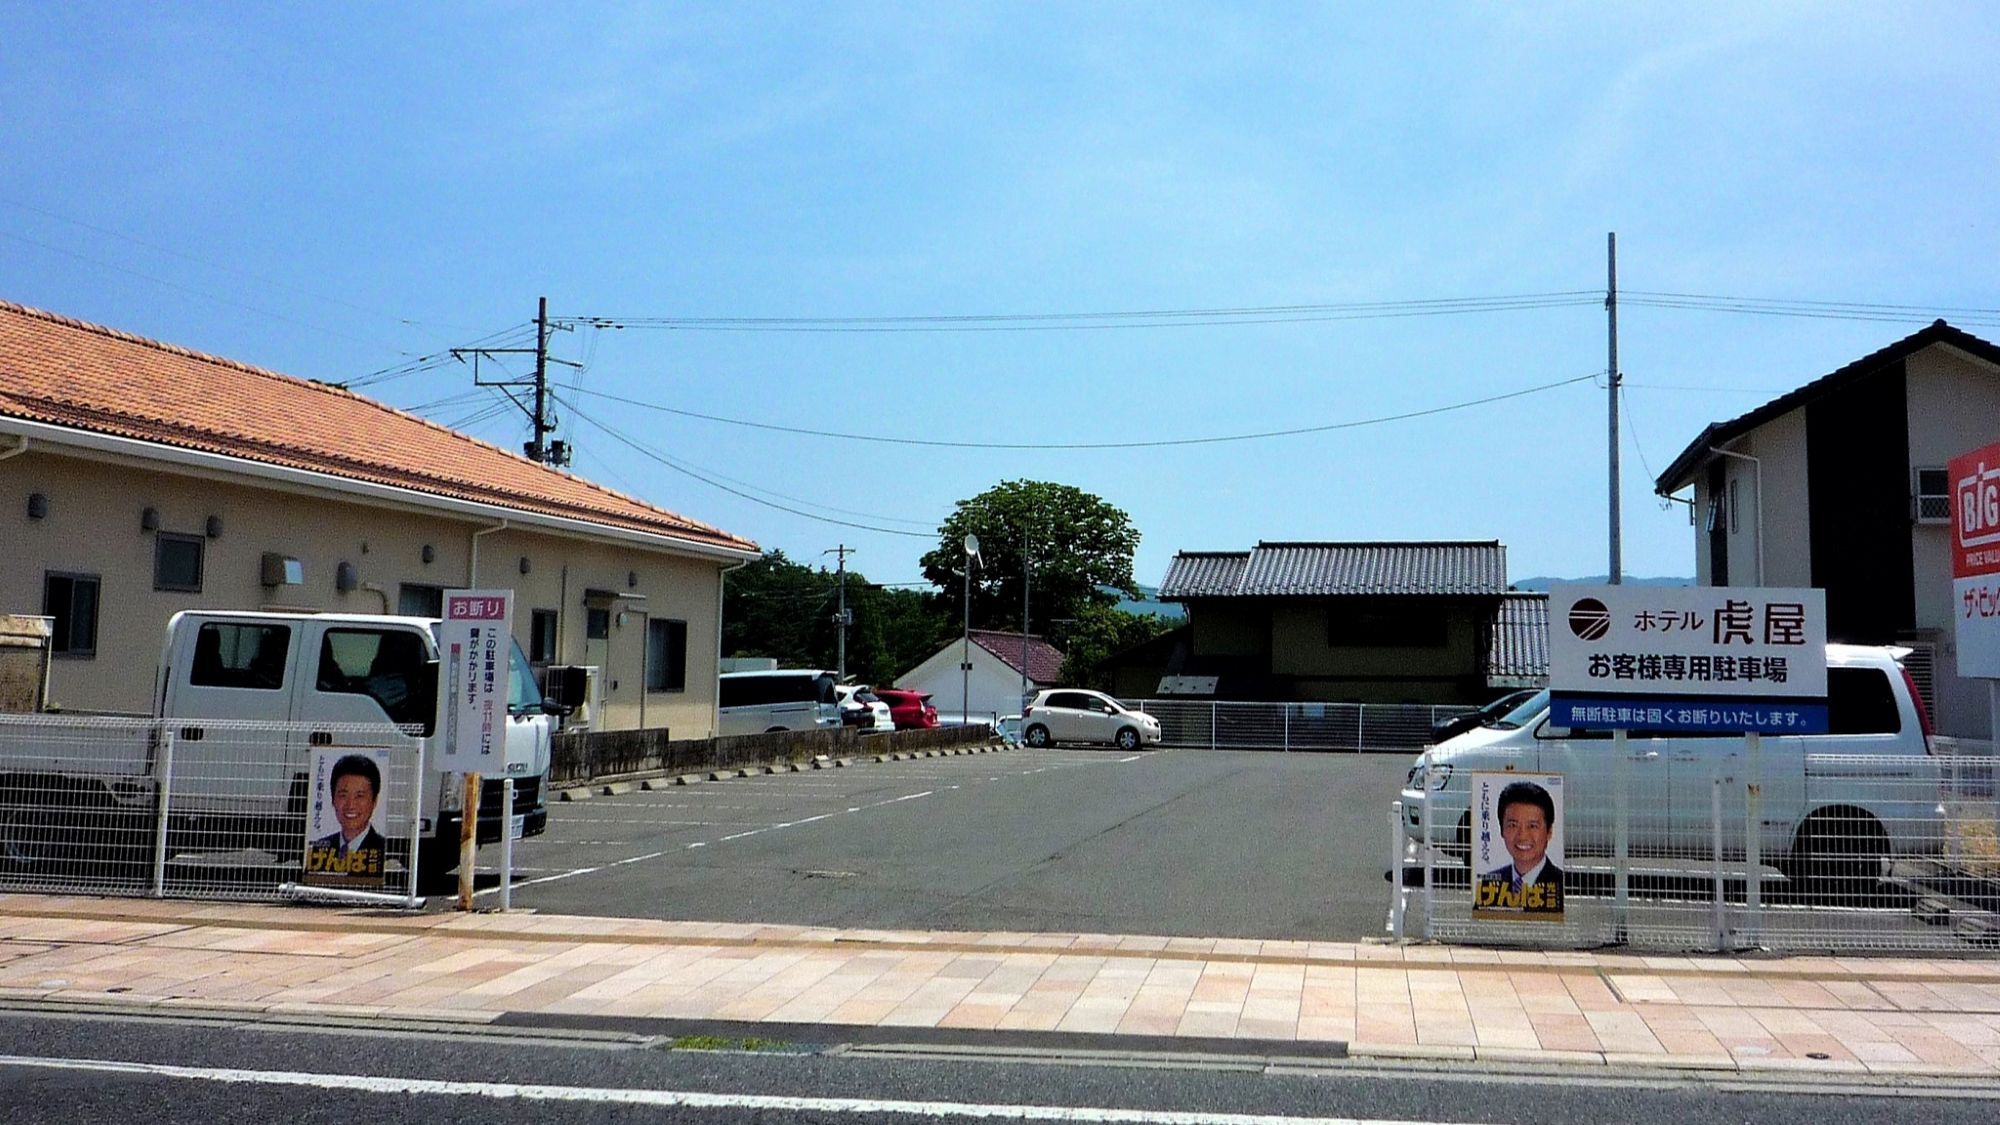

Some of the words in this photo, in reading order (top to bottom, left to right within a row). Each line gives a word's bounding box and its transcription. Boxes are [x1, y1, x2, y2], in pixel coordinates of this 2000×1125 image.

[1963, 462, 1998, 532] BIG
[453, 601, 499, 616] お断り
[1964, 587, 2000, 618] ザ・ビッ
[1634, 610, 1704, 632] ホテル
[1713, 600, 1806, 645] 虎屋
[1588, 653, 1788, 682] お客様専用駐車場
[1571, 705, 1806, 727] 無断駐車は固くお断りいたします。
[307, 847, 367, 873] げんば
[1476, 881, 1545, 908] げんば
